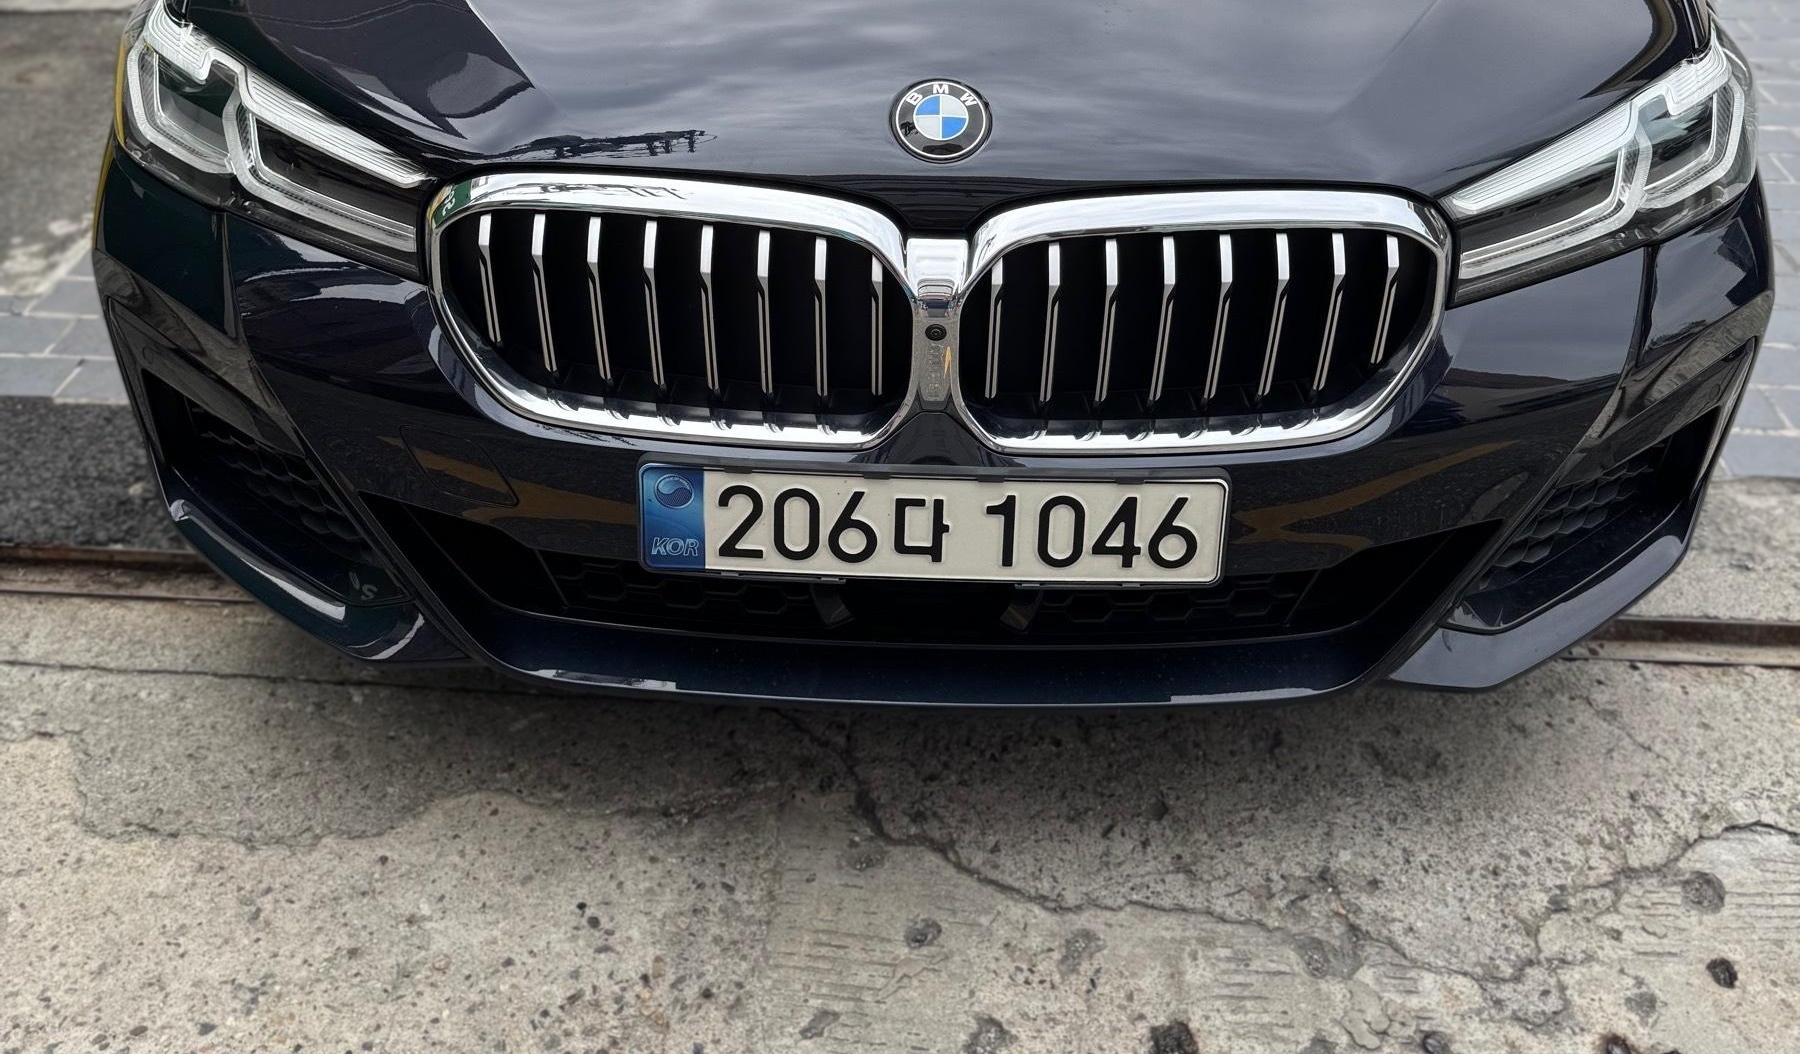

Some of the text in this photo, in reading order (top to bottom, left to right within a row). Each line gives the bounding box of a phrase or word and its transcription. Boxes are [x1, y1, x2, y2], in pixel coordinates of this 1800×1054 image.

[905, 83, 977, 107] BMW
[717, 484, 1198, 569] 206다 1046
[651, 537, 699, 557] KOR
